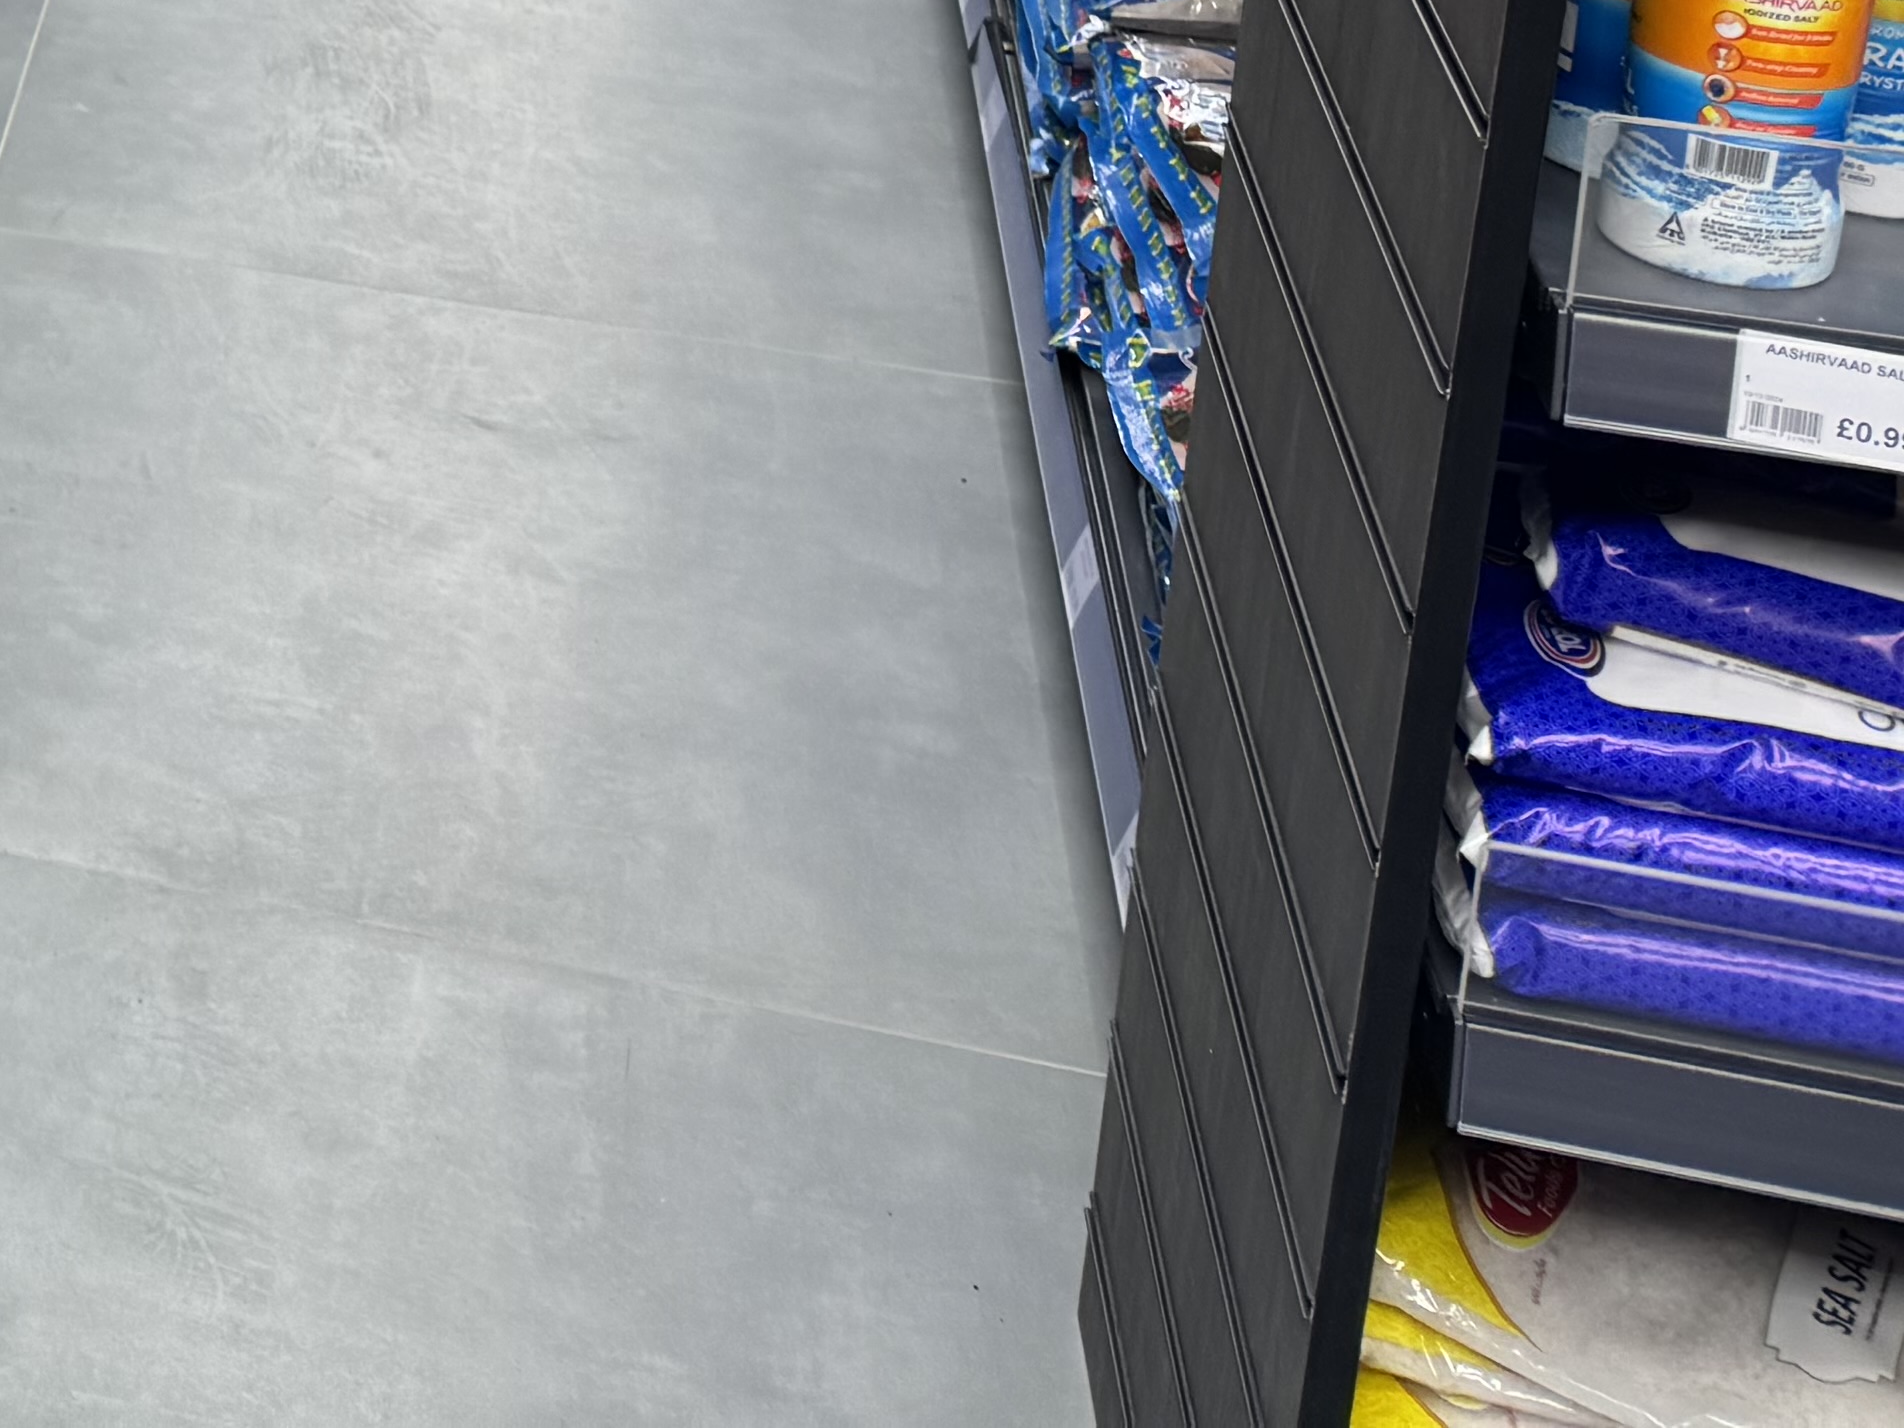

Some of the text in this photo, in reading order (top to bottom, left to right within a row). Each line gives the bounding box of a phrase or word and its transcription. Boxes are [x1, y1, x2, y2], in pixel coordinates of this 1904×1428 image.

[1766, 342, 1872, 374] AASHIRVAAD
[1812, 1229, 1877, 1335] SEA SALT
